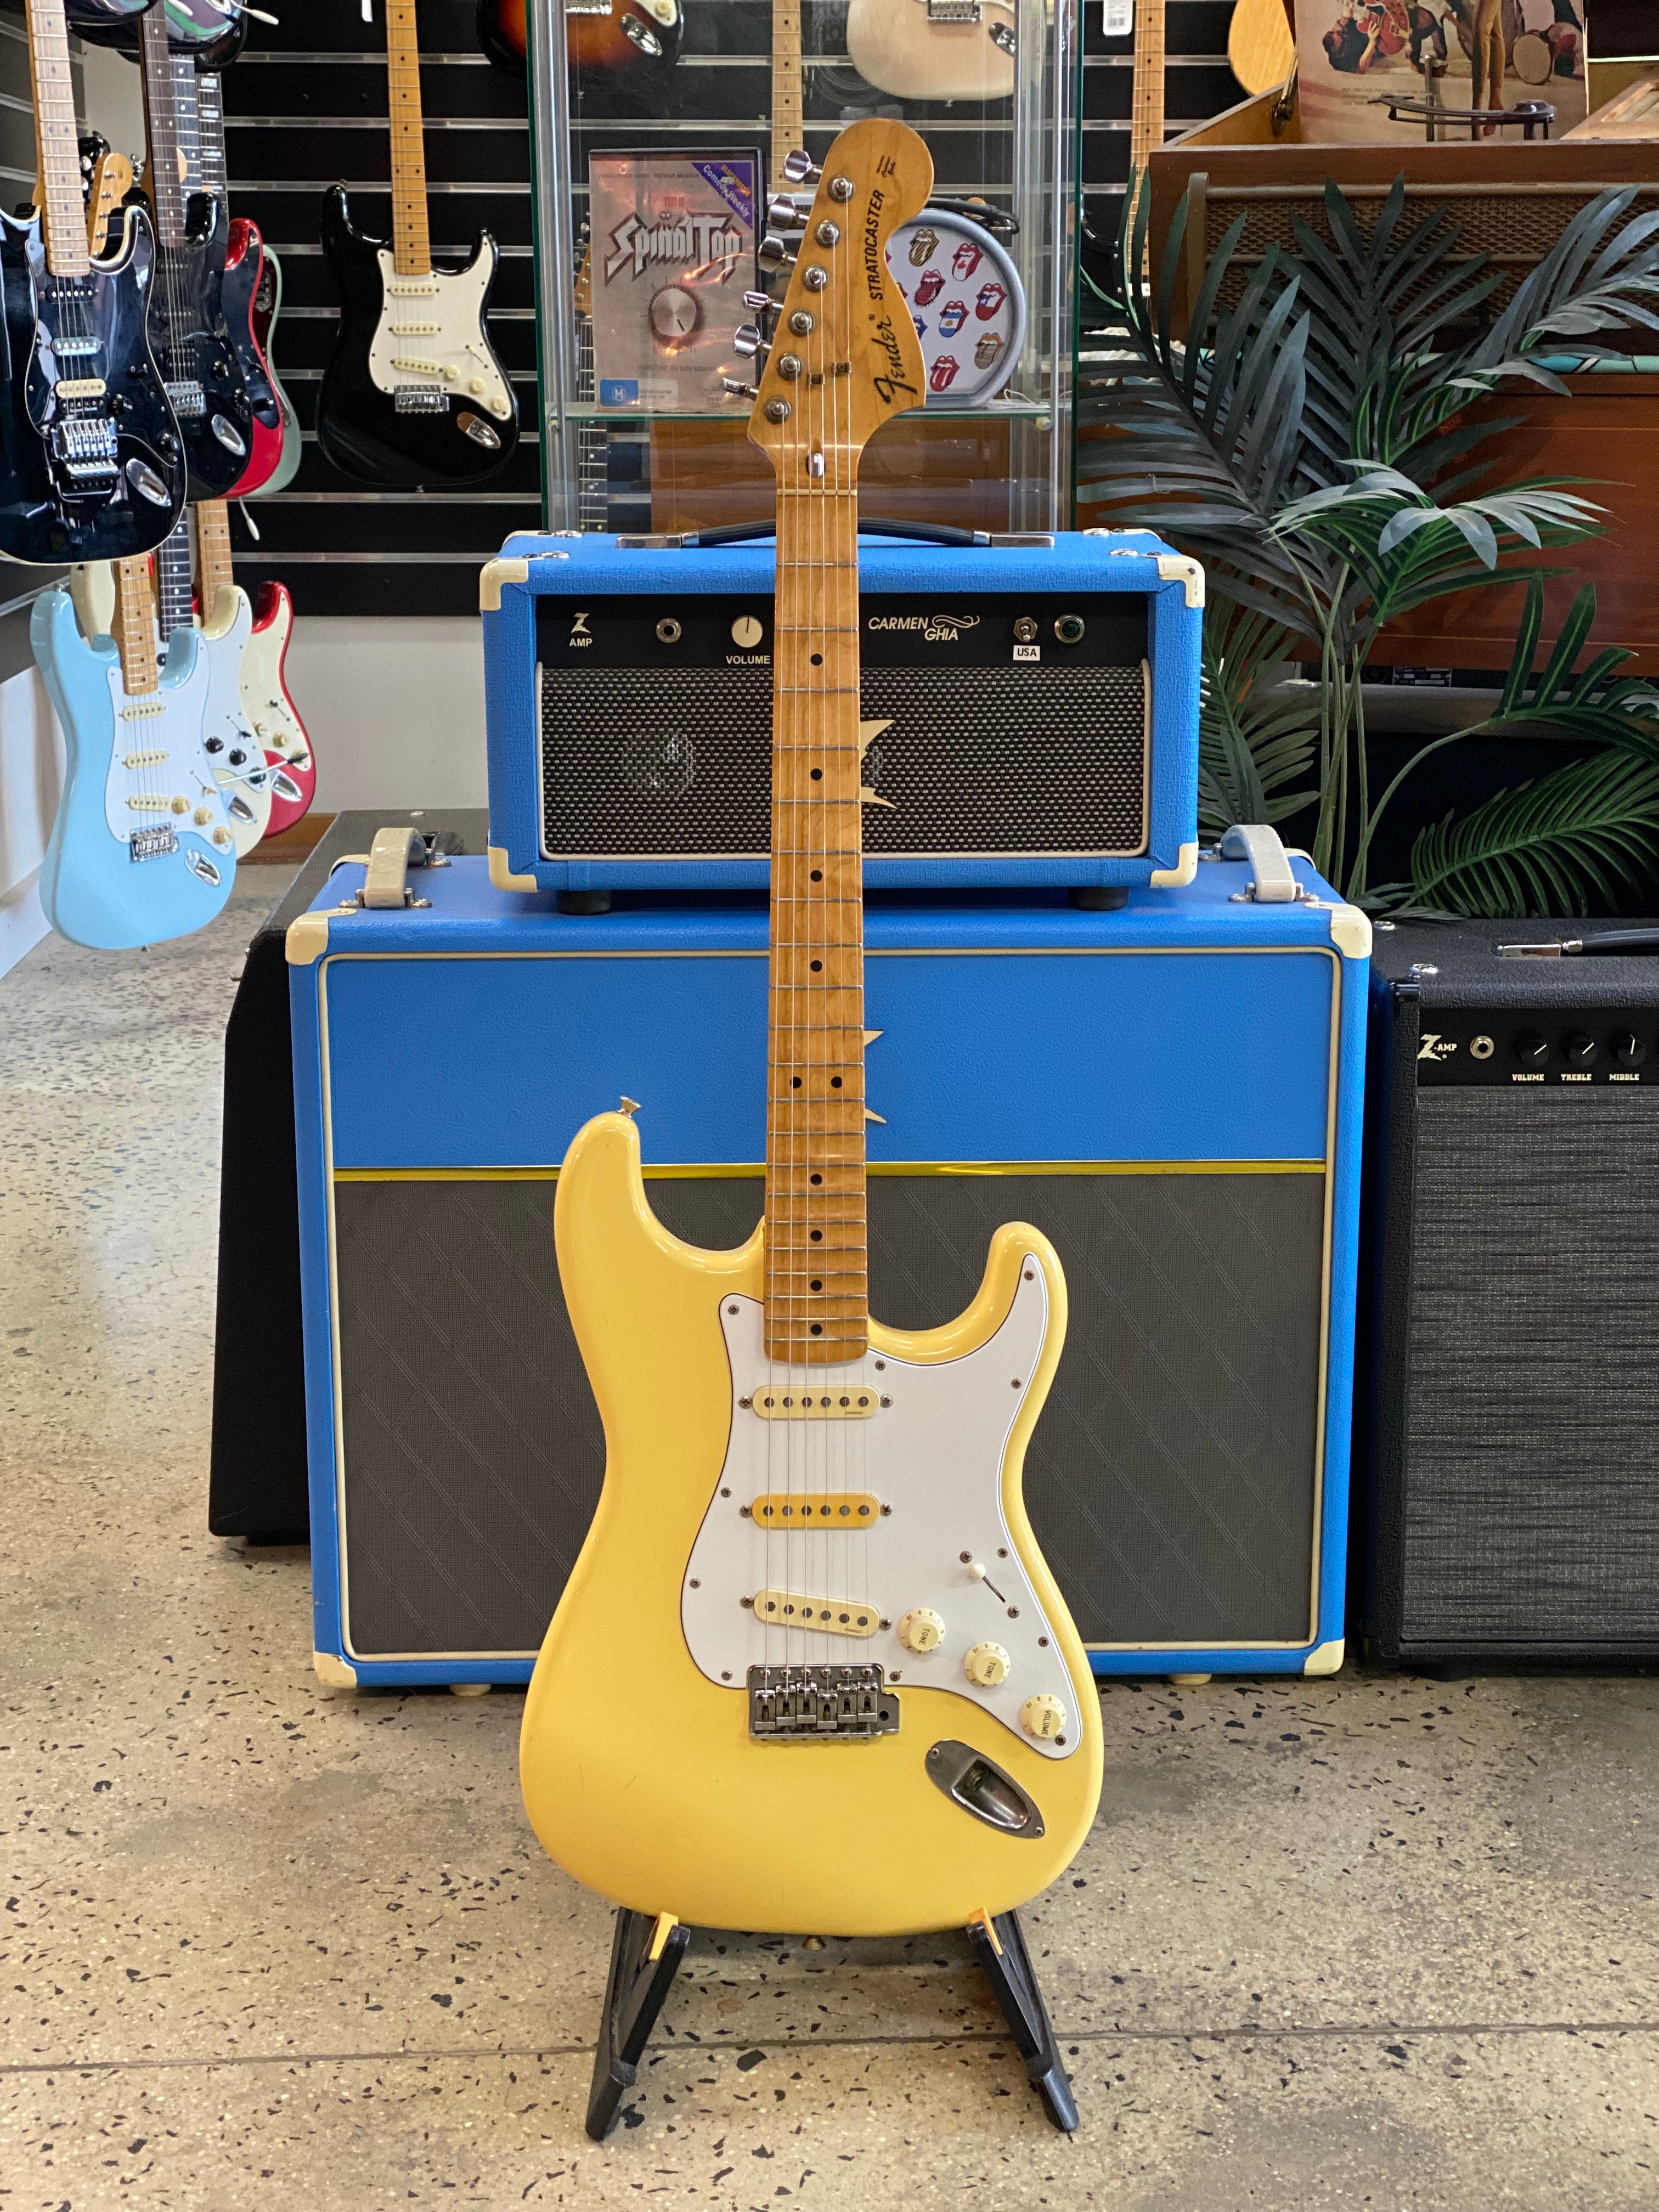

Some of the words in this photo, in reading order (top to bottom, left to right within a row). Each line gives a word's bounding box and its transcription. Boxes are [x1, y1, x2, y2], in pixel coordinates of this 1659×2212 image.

[703, 165, 728, 194] Comedy
[727, 191, 750, 217] Weekly
[663, 196, 678, 207] THIS
[686, 208, 743, 285] Tap
[865, 189, 885, 300] STRATOCASTER
[871, 314, 918, 404] Fender
[614, 388, 624, 399] M
[868, 617, 929, 630] CARMEN
[569, 637, 593, 647] AMP
[924, 628, 959, 641] GHIA
[725, 655, 771, 664] VOLUME
[1017, 647, 1037, 657] USA
[918, 1628, 930, 1645] TONE
[984, 1661, 996, 1679] TONE
[1041, 1709, 1052, 1736] VOLUME
